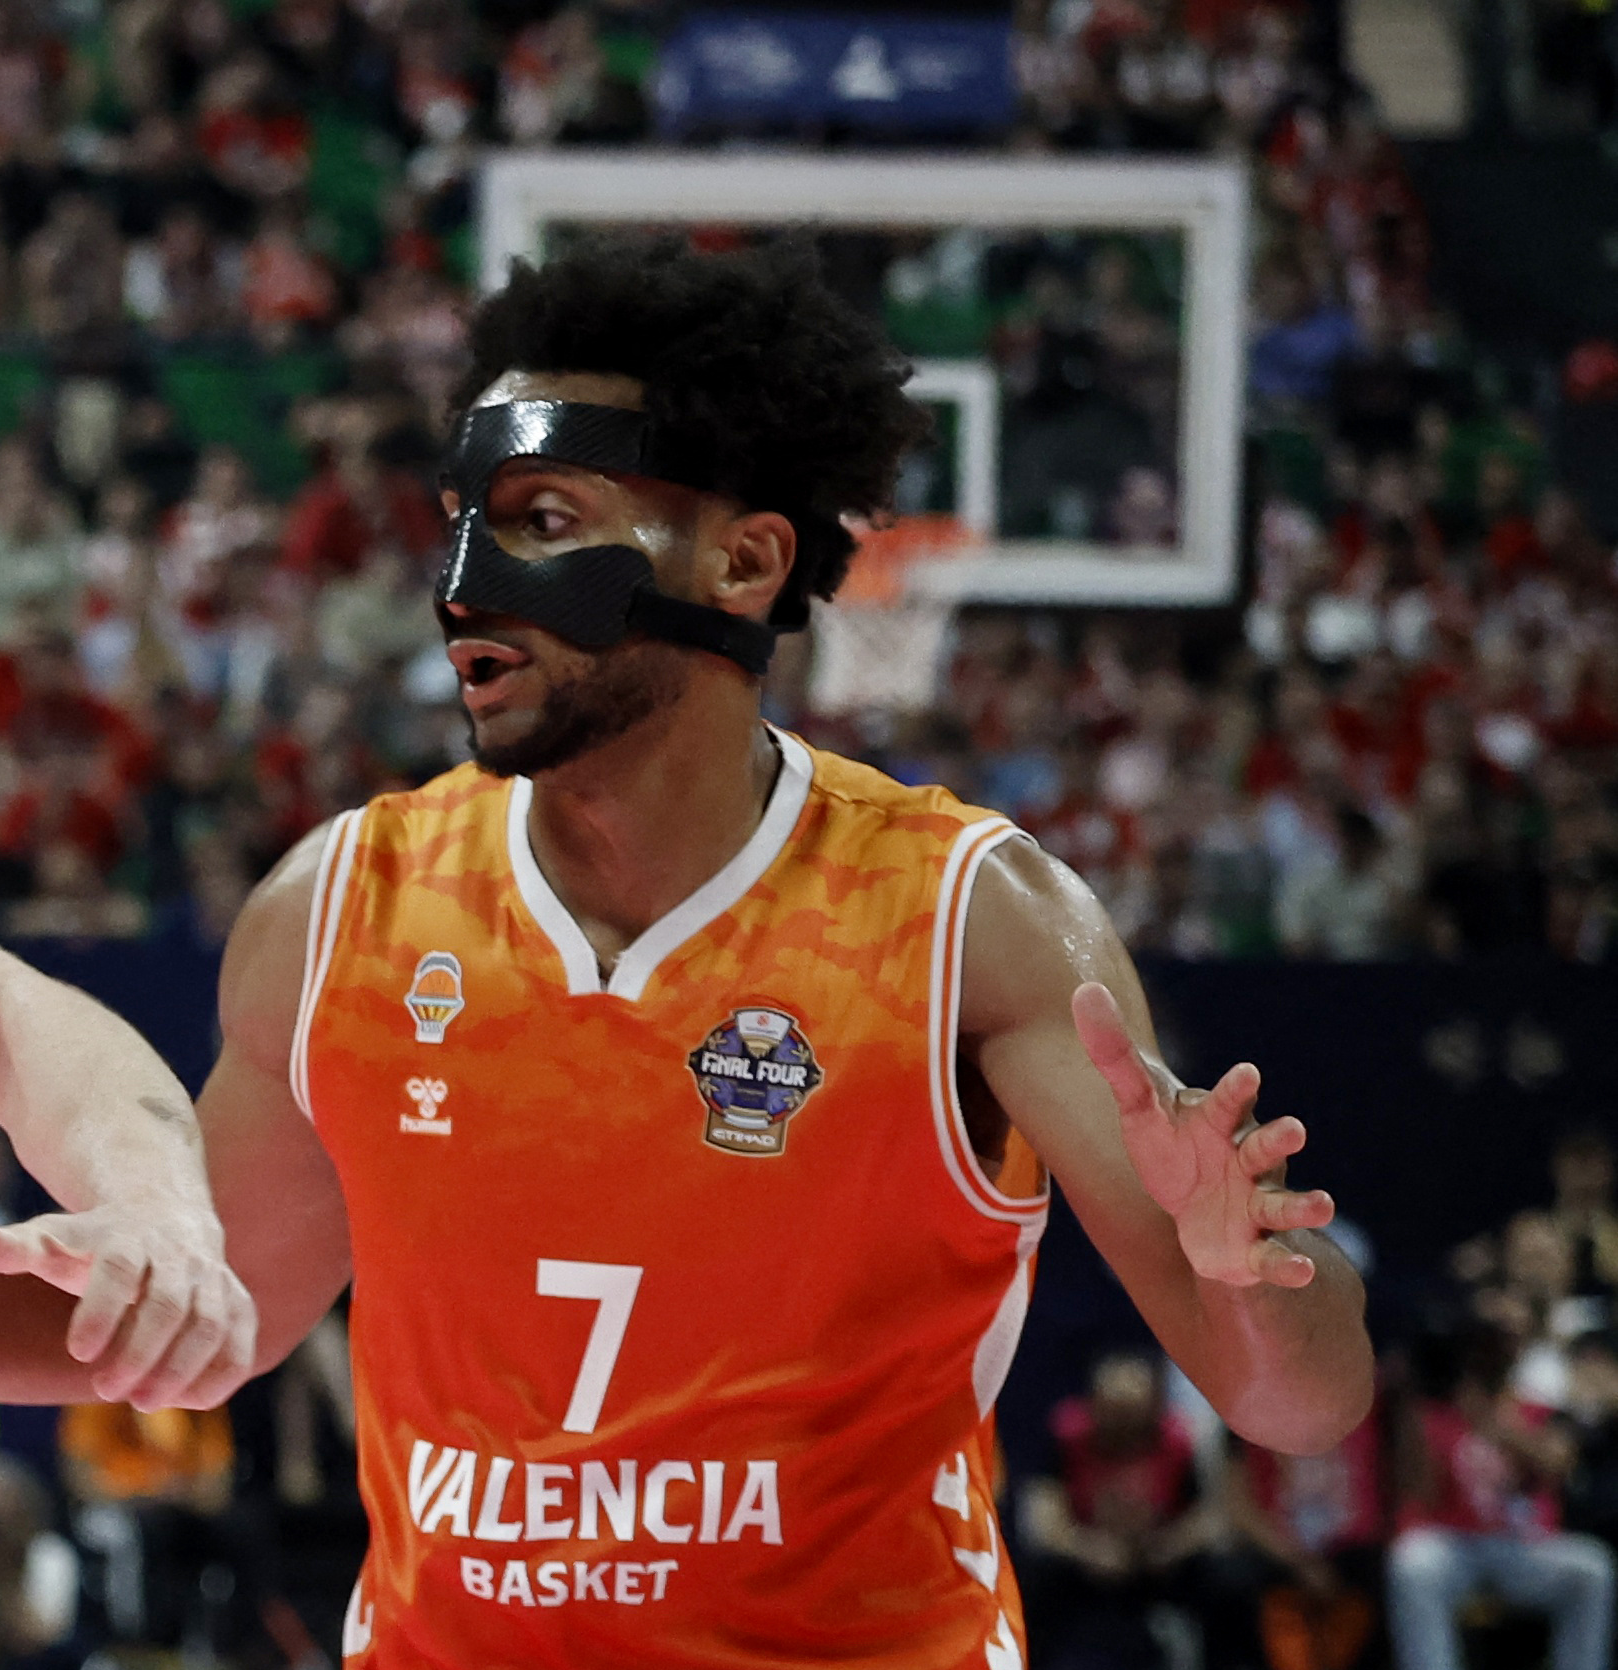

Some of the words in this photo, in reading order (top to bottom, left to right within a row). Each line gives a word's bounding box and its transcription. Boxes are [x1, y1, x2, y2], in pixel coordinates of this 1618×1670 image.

[700, 1052, 754, 1081] FINAL
[756, 1060, 808, 1088] FOUR
[537, 1258, 644, 1434] 7
[407, 1438, 784, 1546] VALENCIA
[459, 1555, 679, 1607] BASKET
